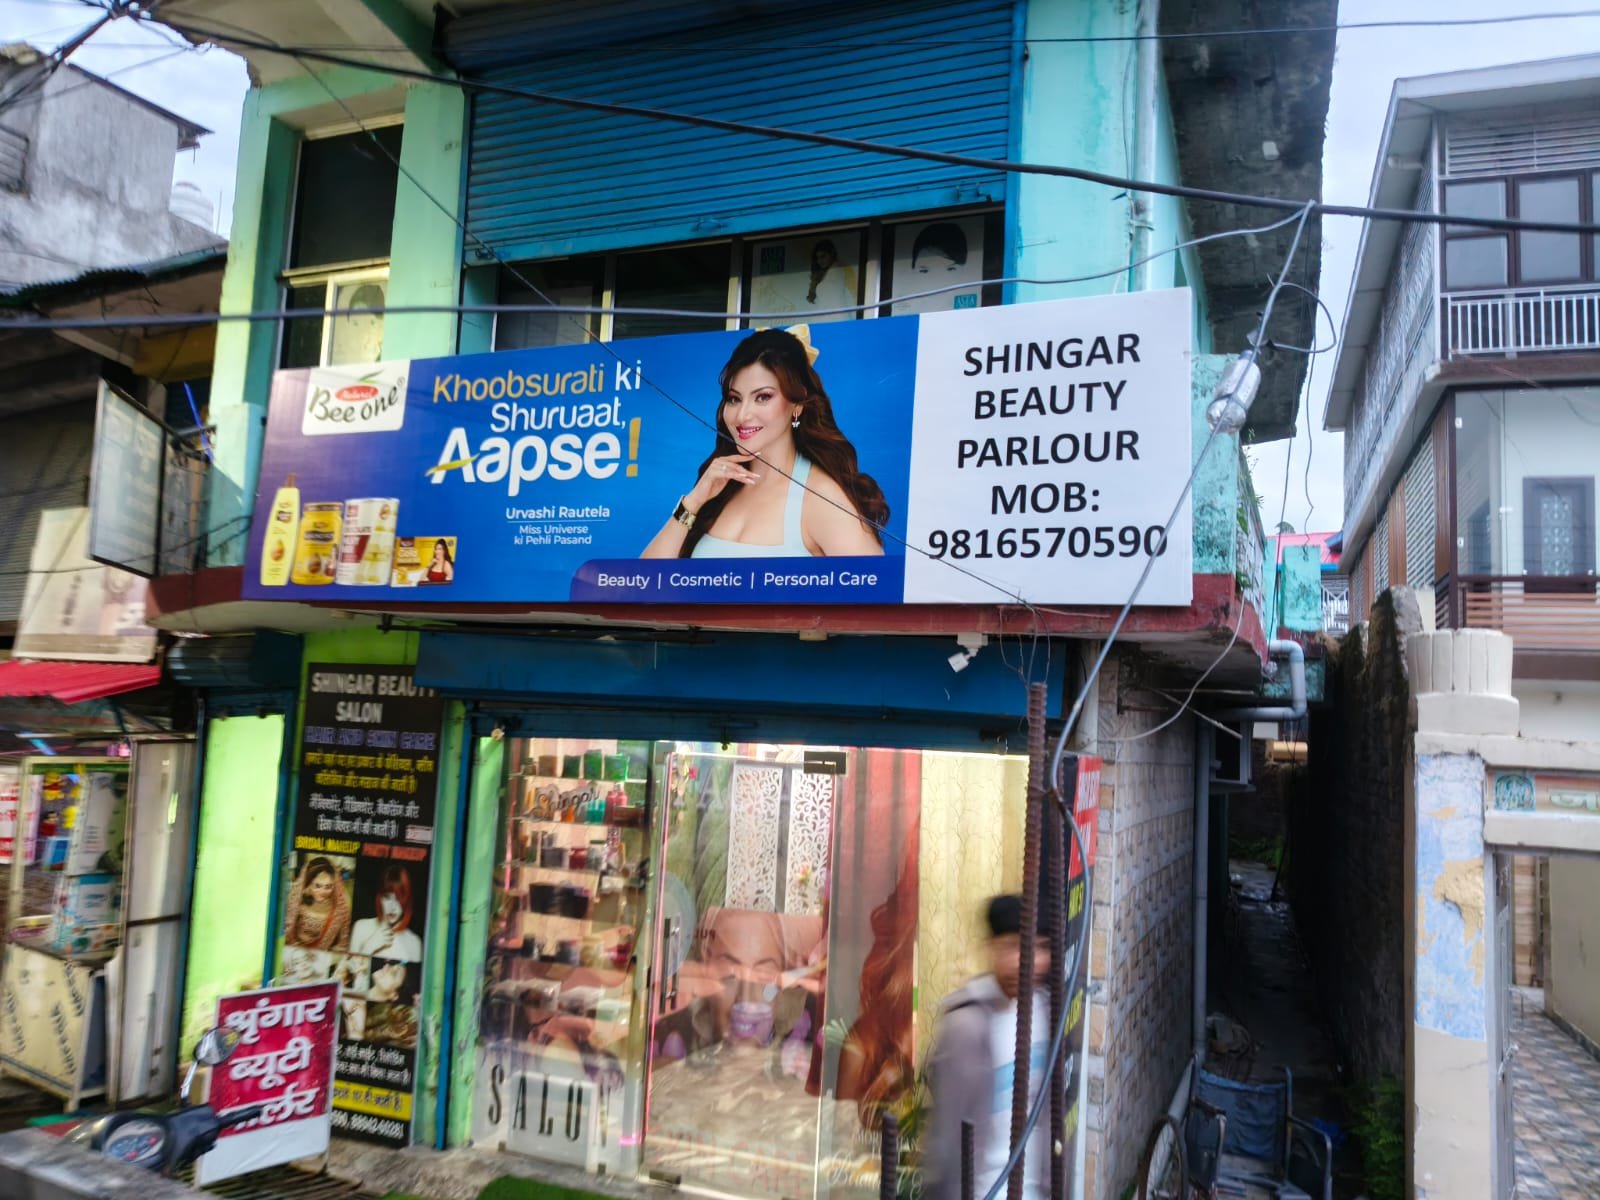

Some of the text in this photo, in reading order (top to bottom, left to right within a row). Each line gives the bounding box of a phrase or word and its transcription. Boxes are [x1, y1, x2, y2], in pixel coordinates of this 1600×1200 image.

[963, 333, 1140, 377] SHINGAR
[433, 359, 642, 404] Khoobsurati ki
[490, 396, 626, 433] Shuruaat,
[974, 380, 1127, 420] BEAUTY
[425, 416, 642, 497] Aapse!
[958, 430, 1139, 469] PARLOUR
[506, 506, 610, 519] Urvashi Rautela
[991, 483, 1100, 515] MOB:
[514, 535, 592, 545] ki Pehli Pasand
[519, 525, 588, 534] Miss Universe
[928, 525, 1165, 560] 9816570590
[597, 571, 878, 590] Beauty Cosmetic Personal Care
[311, 671, 375, 695] SHINGAR
[335, 700, 383, 723] SALON
[228, 1036, 315, 1090] ब्यूटी
